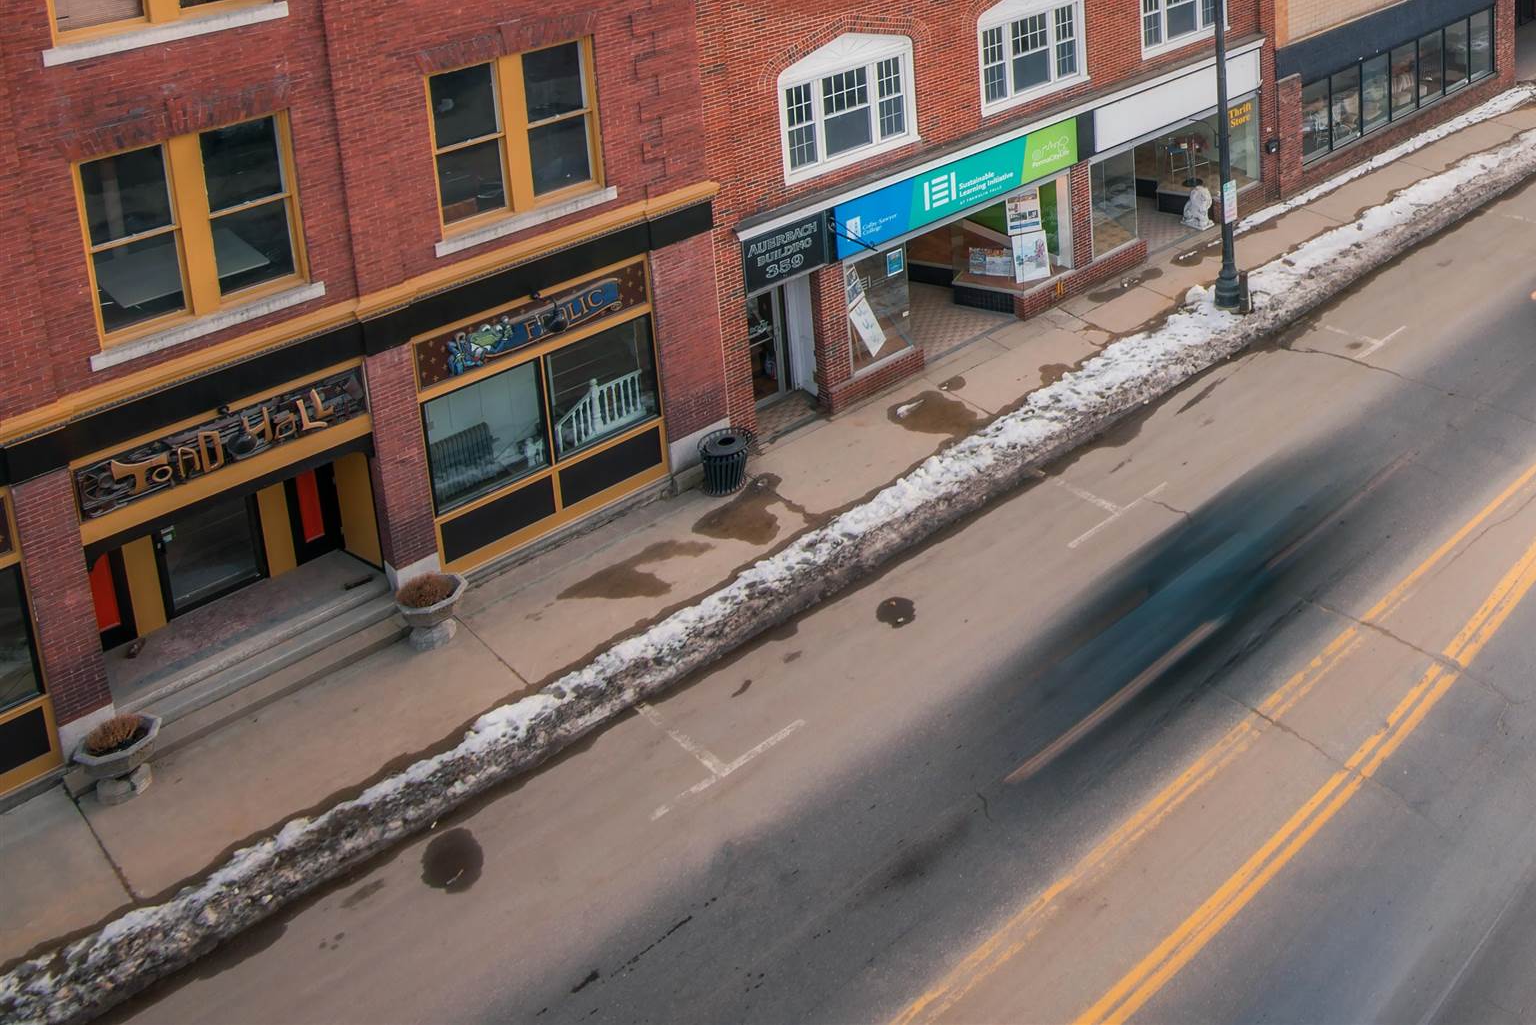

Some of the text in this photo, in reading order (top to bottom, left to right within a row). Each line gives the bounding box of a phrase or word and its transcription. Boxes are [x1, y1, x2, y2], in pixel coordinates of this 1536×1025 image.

[1228, 102, 1252, 119] Thrift
[1230, 114, 1250, 128] Store
[958, 171, 995, 190] Sustainable
[959, 171, 1014, 198] Learning Initiative
[747, 220, 818, 259] AUERBACH
[757, 237, 813, 268] BUILDING
[765, 253, 804, 279] 359
